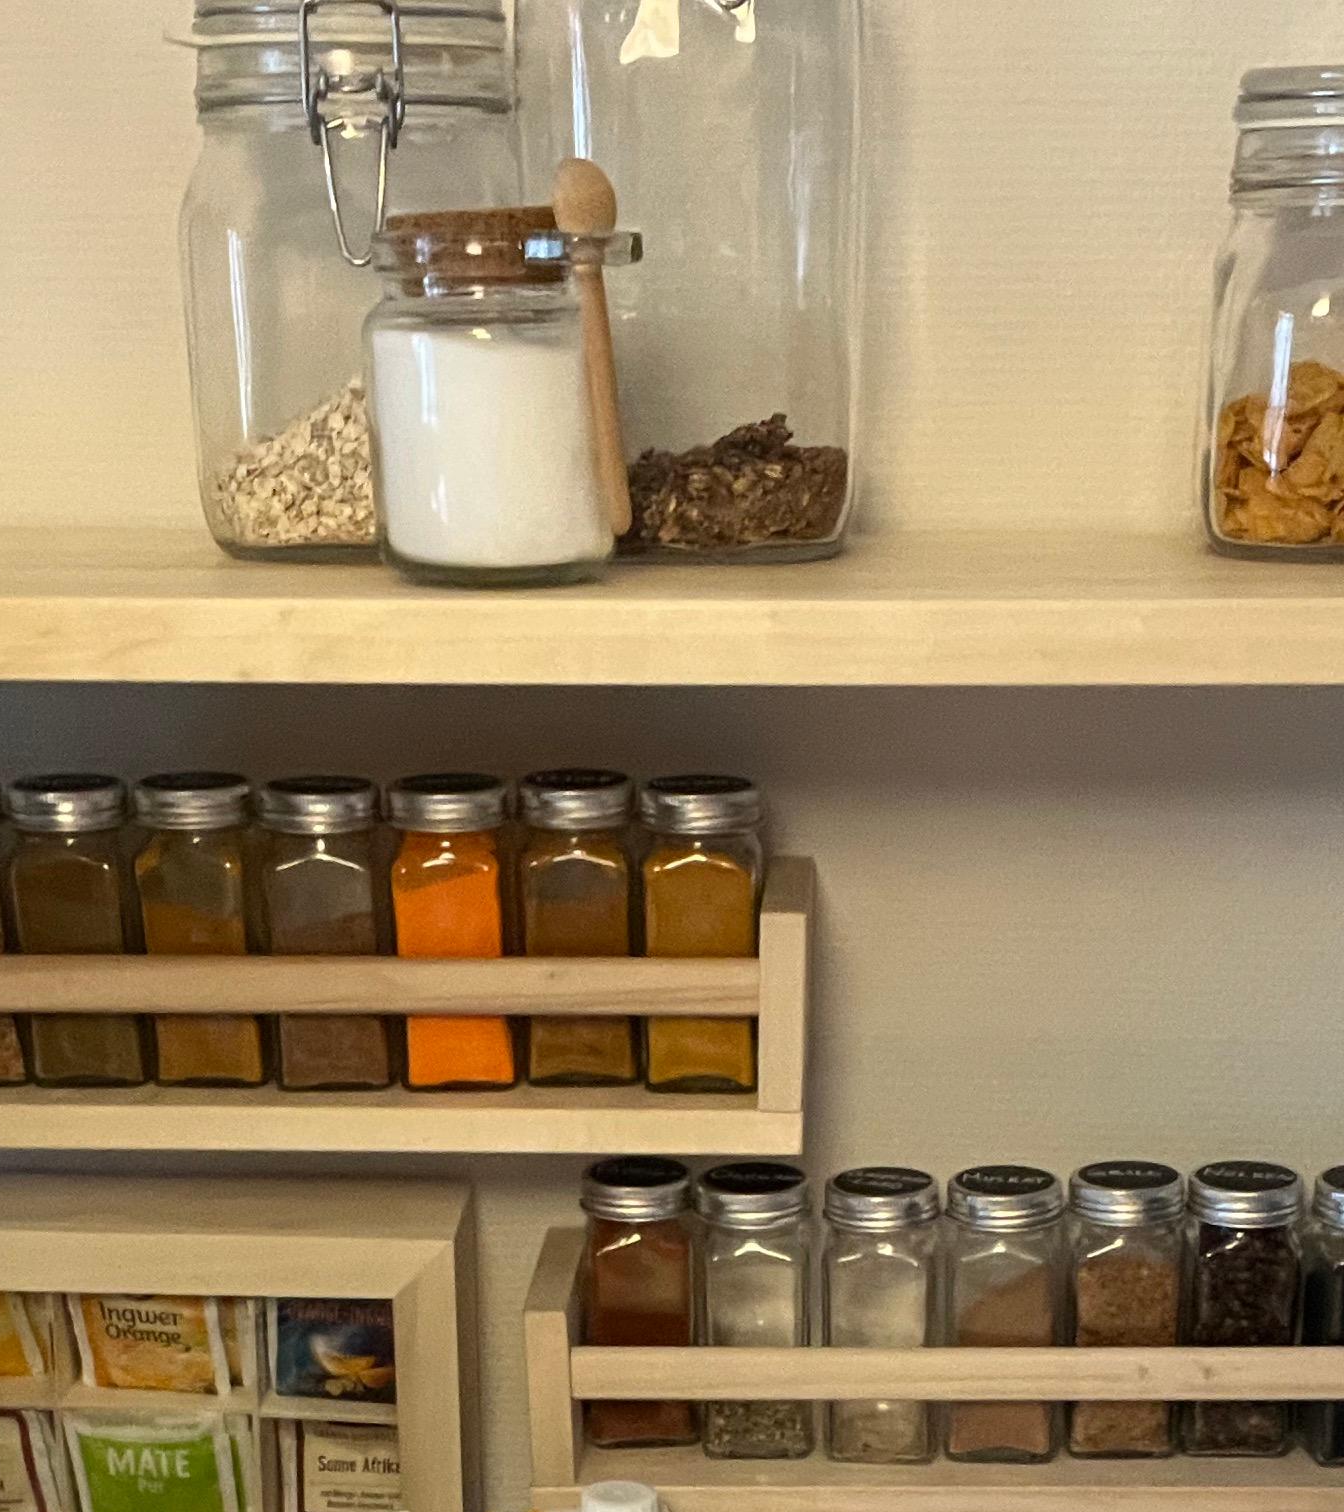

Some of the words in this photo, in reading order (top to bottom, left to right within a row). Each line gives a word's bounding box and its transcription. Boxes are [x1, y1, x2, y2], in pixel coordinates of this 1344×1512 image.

[98, 1301, 184, 1328] Ingwer
[106, 1323, 181, 1347] Orange
[107, 1446, 191, 1479] MATE
